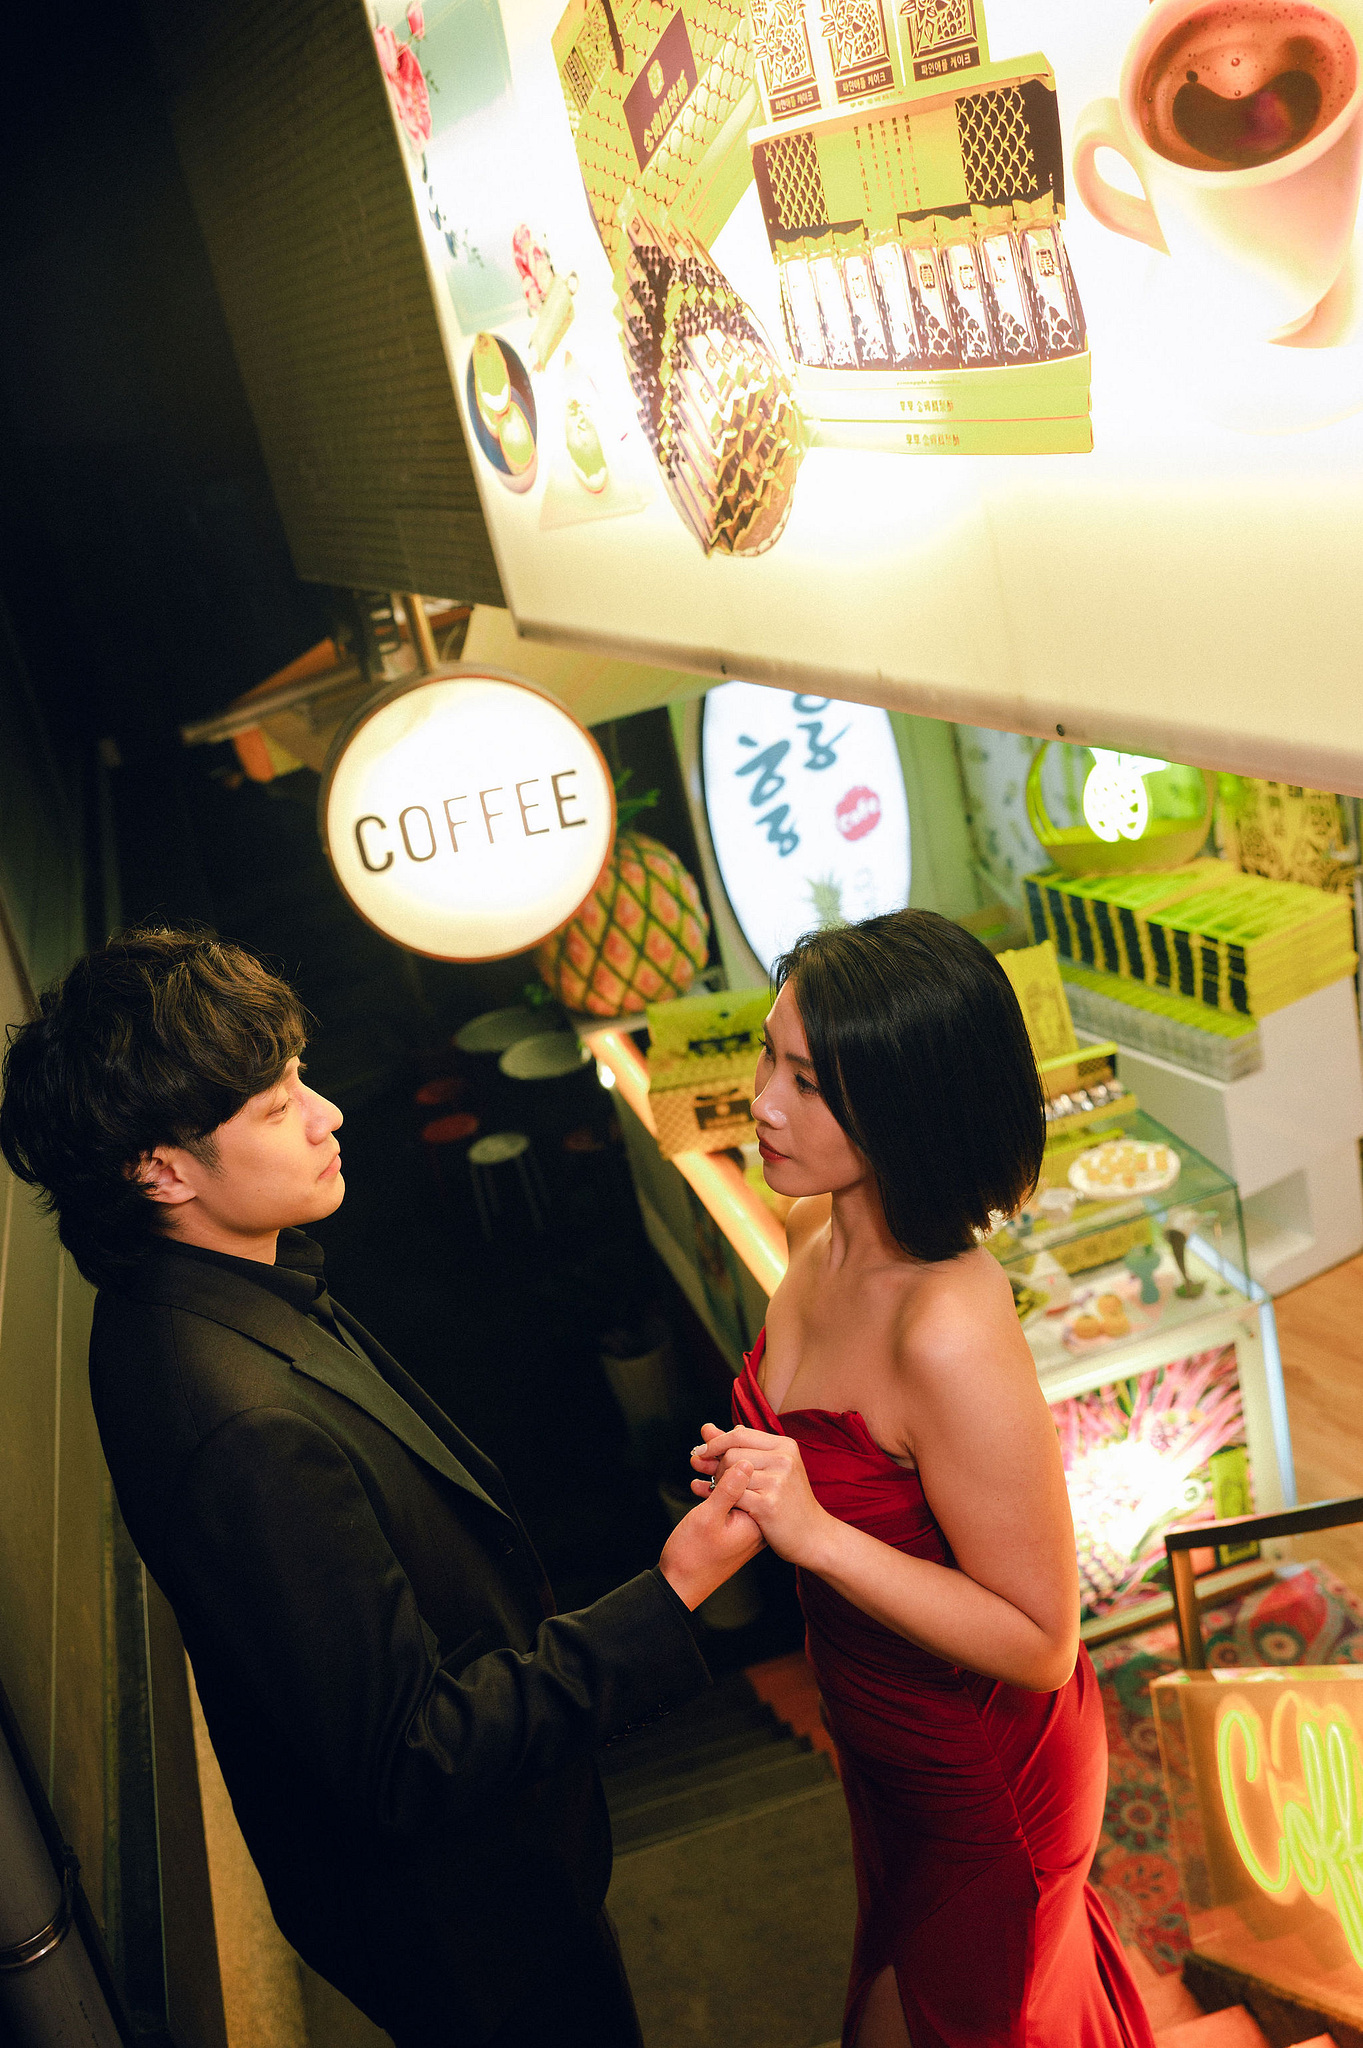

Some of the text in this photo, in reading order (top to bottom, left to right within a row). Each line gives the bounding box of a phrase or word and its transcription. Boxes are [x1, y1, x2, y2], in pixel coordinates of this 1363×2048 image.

[921, 52, 972, 76] 파인애플 케이크
[354, 769, 587, 873] COFFEE
